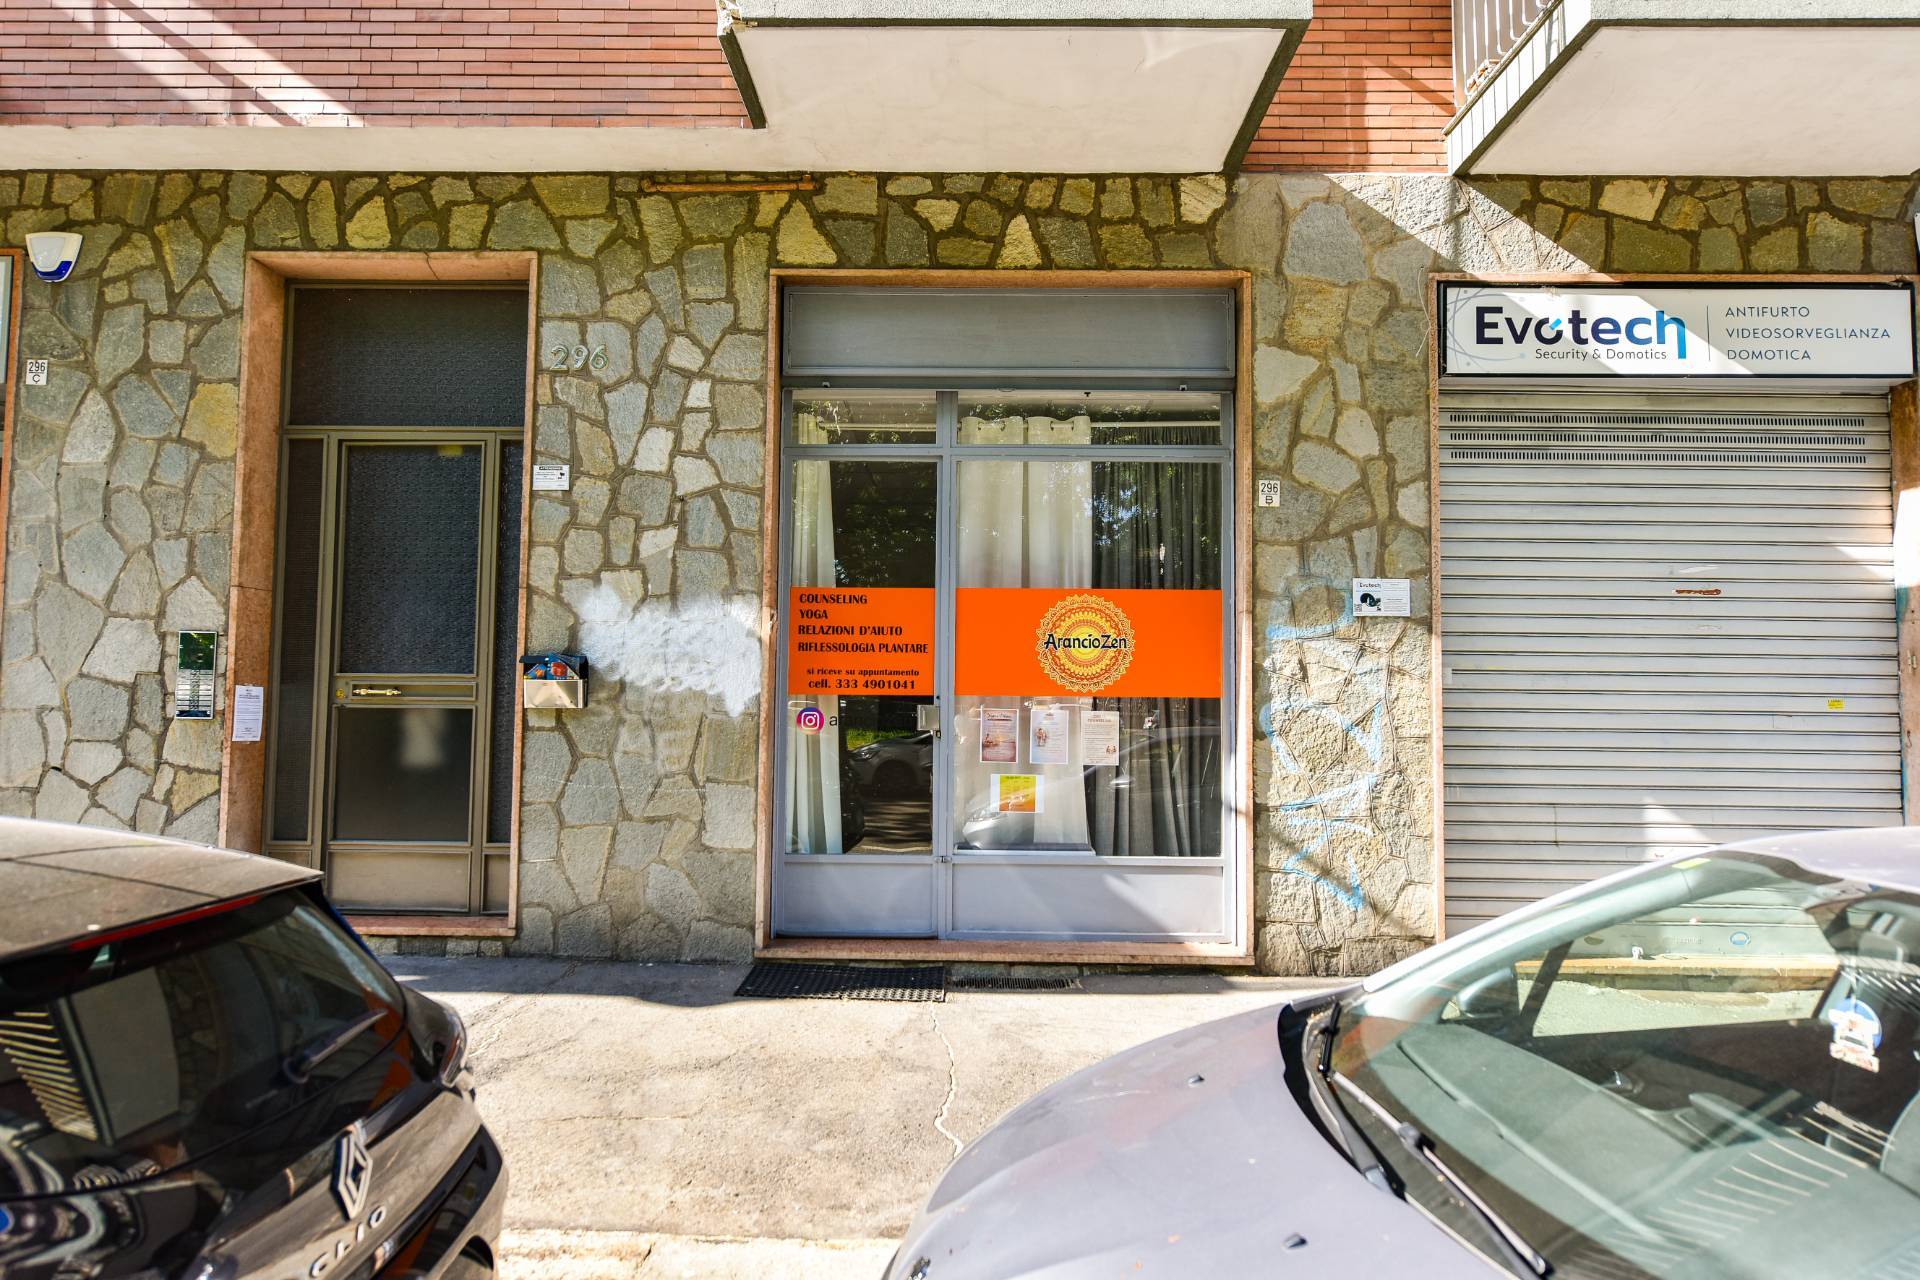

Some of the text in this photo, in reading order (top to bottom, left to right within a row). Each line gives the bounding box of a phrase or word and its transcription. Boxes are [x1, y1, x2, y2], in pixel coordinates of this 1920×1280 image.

[1725, 306, 1810, 318] ANTIFURTO
[1475, 306, 1687, 359] Evotech
[1726, 327, 1891, 339] VIDEOSORVEGLIANZA
[550, 344, 609, 371] 296
[1535, 348, 1667, 361] Security & Domotics
[1727, 349, 1812, 361] DOMOTICA
[29, 361, 46, 372] 296
[32, 374, 41, 383] C
[1260, 482, 1279, 493] 296
[1265, 495, 1274, 504] B
[799, 593, 867, 604] COUNSELING
[799, 609, 827, 619] YOGA
[798, 624, 902, 636] RELAZIONI D'AIUTO
[798, 641, 928, 654] RIFLESSOLOGIA PLANTARE
[1043, 633, 1128, 651] ArancioZen
[817, 667, 842, 675] riceve
[858, 668, 919, 677] appuntamento
[808, 678, 915, 689] cell. 333 4901041
[309, 1205, 386, 1278] CLIO
